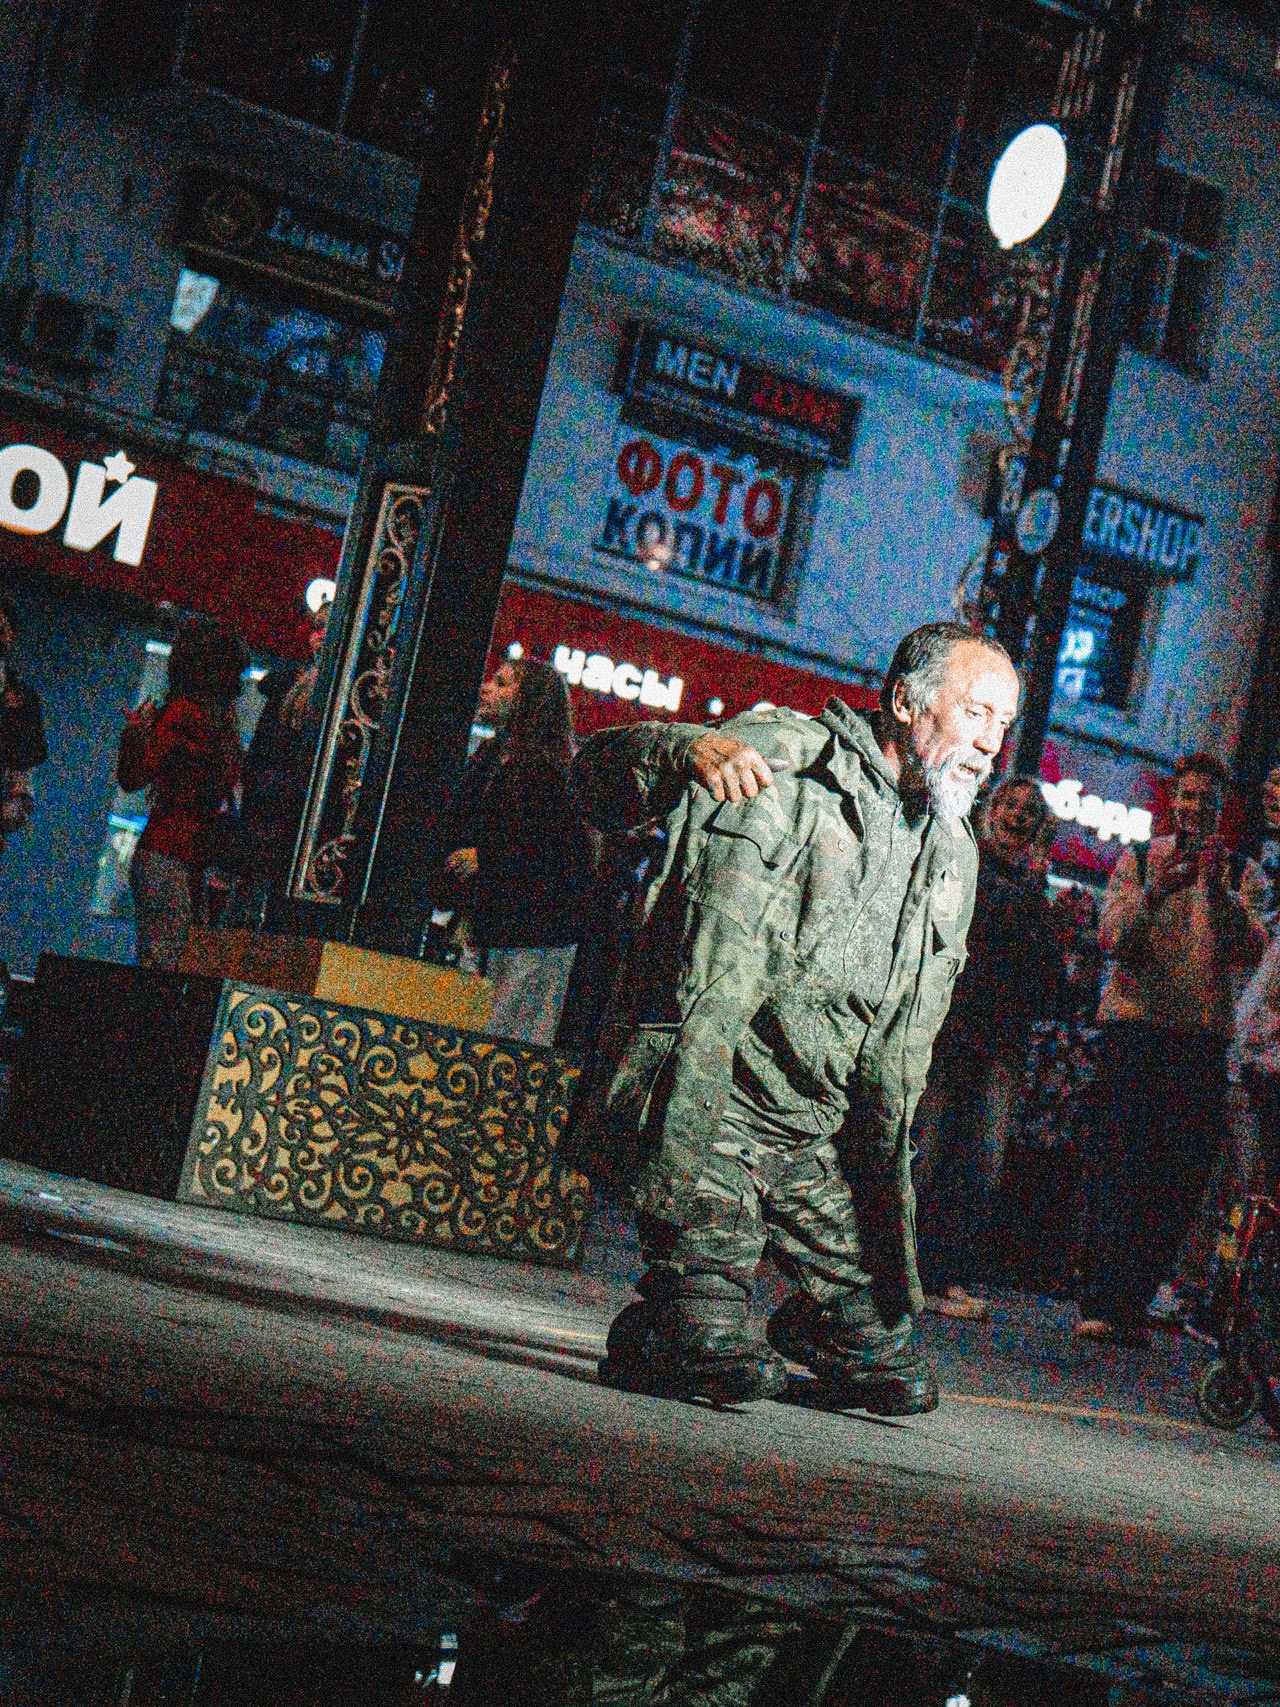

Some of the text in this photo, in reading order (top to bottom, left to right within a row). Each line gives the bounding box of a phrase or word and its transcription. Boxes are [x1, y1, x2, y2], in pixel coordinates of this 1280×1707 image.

[655, 339, 742, 398] MEN
[617, 440, 783, 538] ФОТО
[1082, 486, 1201, 572] ERSHOP
[603, 499, 774, 592] КОПИИ
[554, 644, 685, 712] часы
